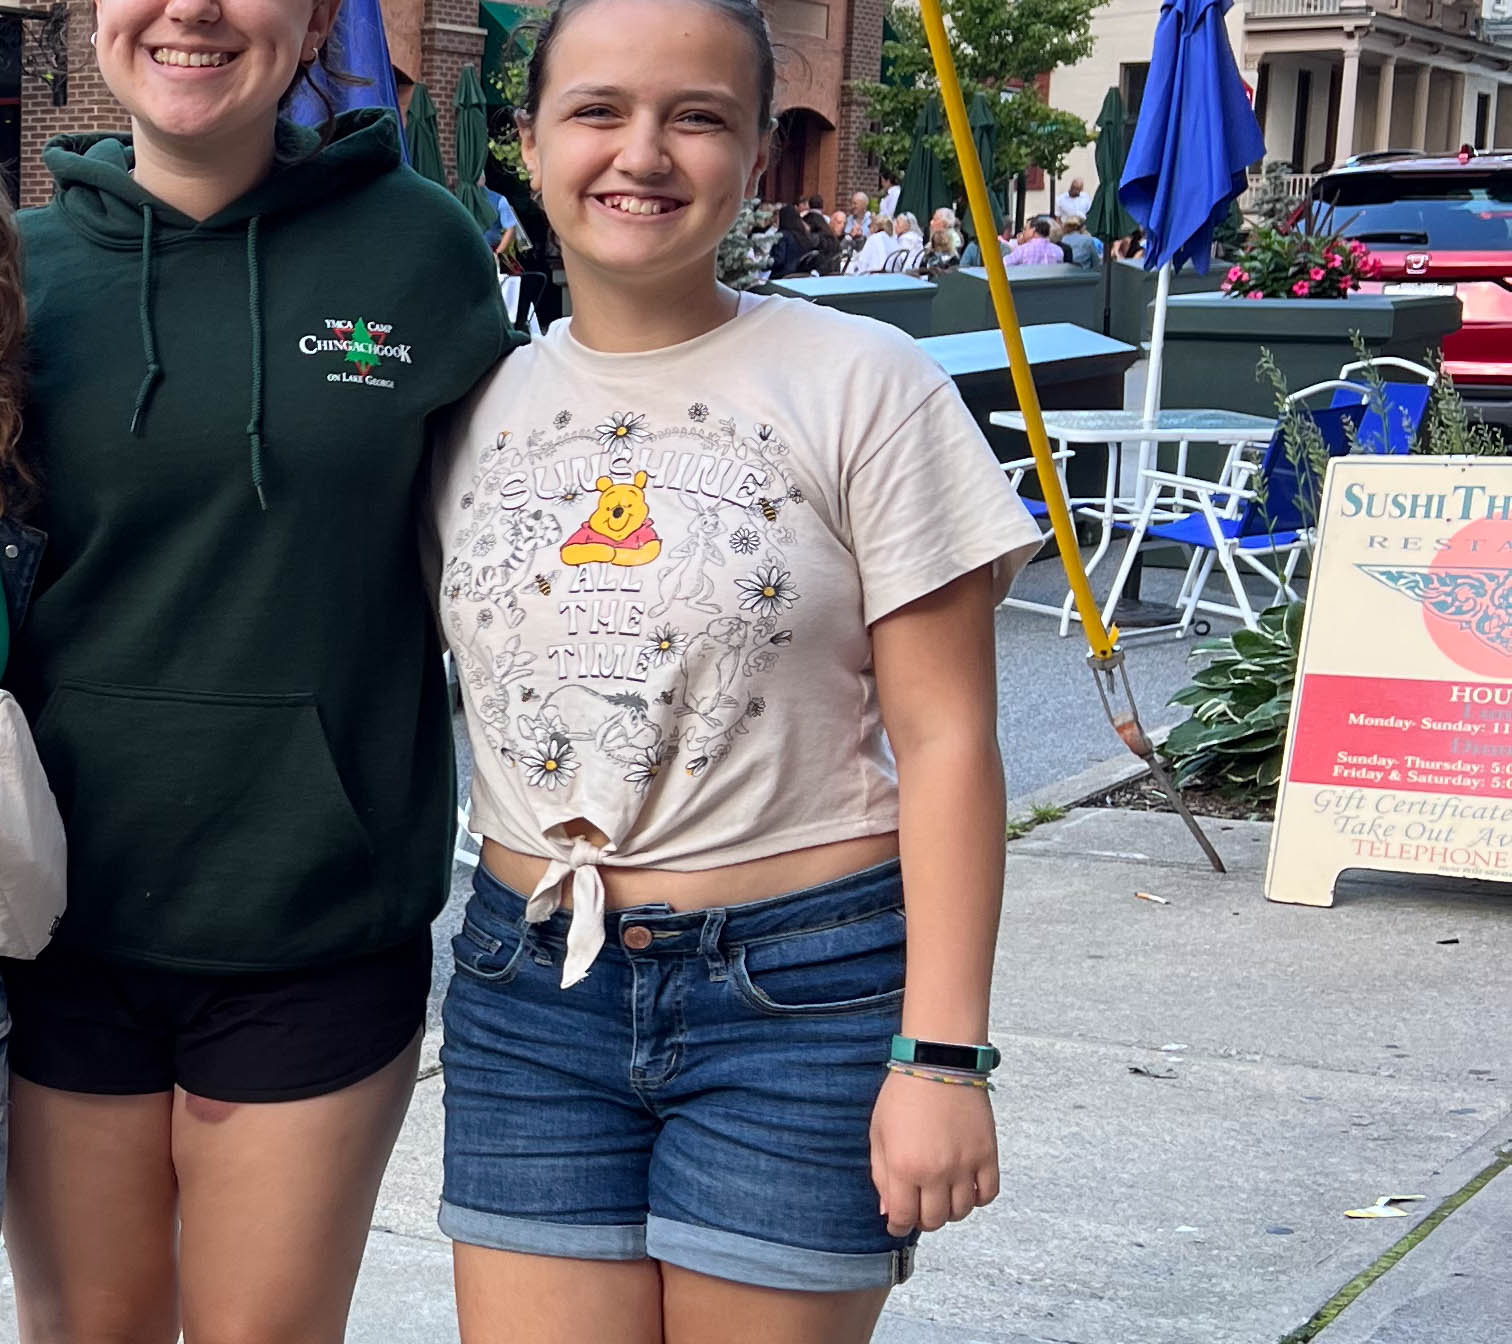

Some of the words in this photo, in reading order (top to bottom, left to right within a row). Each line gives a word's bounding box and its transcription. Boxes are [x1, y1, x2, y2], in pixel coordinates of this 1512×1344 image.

[324, 319, 354, 329] YMCA
[498, 449, 768, 511] SUNSHINE
[1340, 482, 1447, 519] SUSHI
[568, 564, 642, 593] ALL
[559, 600, 646, 637] THE
[548, 644, 650, 682] TIME
[1420, 717, 1486, 735] Sunday:
[1332, 765, 1384, 782] Friday
[1388, 769, 1400, 781] &
[1406, 770, 1485, 789] Saturday:
[1404, 755, 1485, 773] Thursday:
[1313, 788, 1367, 816] Gift
[1334, 814, 1396, 842] Take
[1404, 821, 1455, 842] Out
[1352, 838, 1509, 869] TELEPHONE
